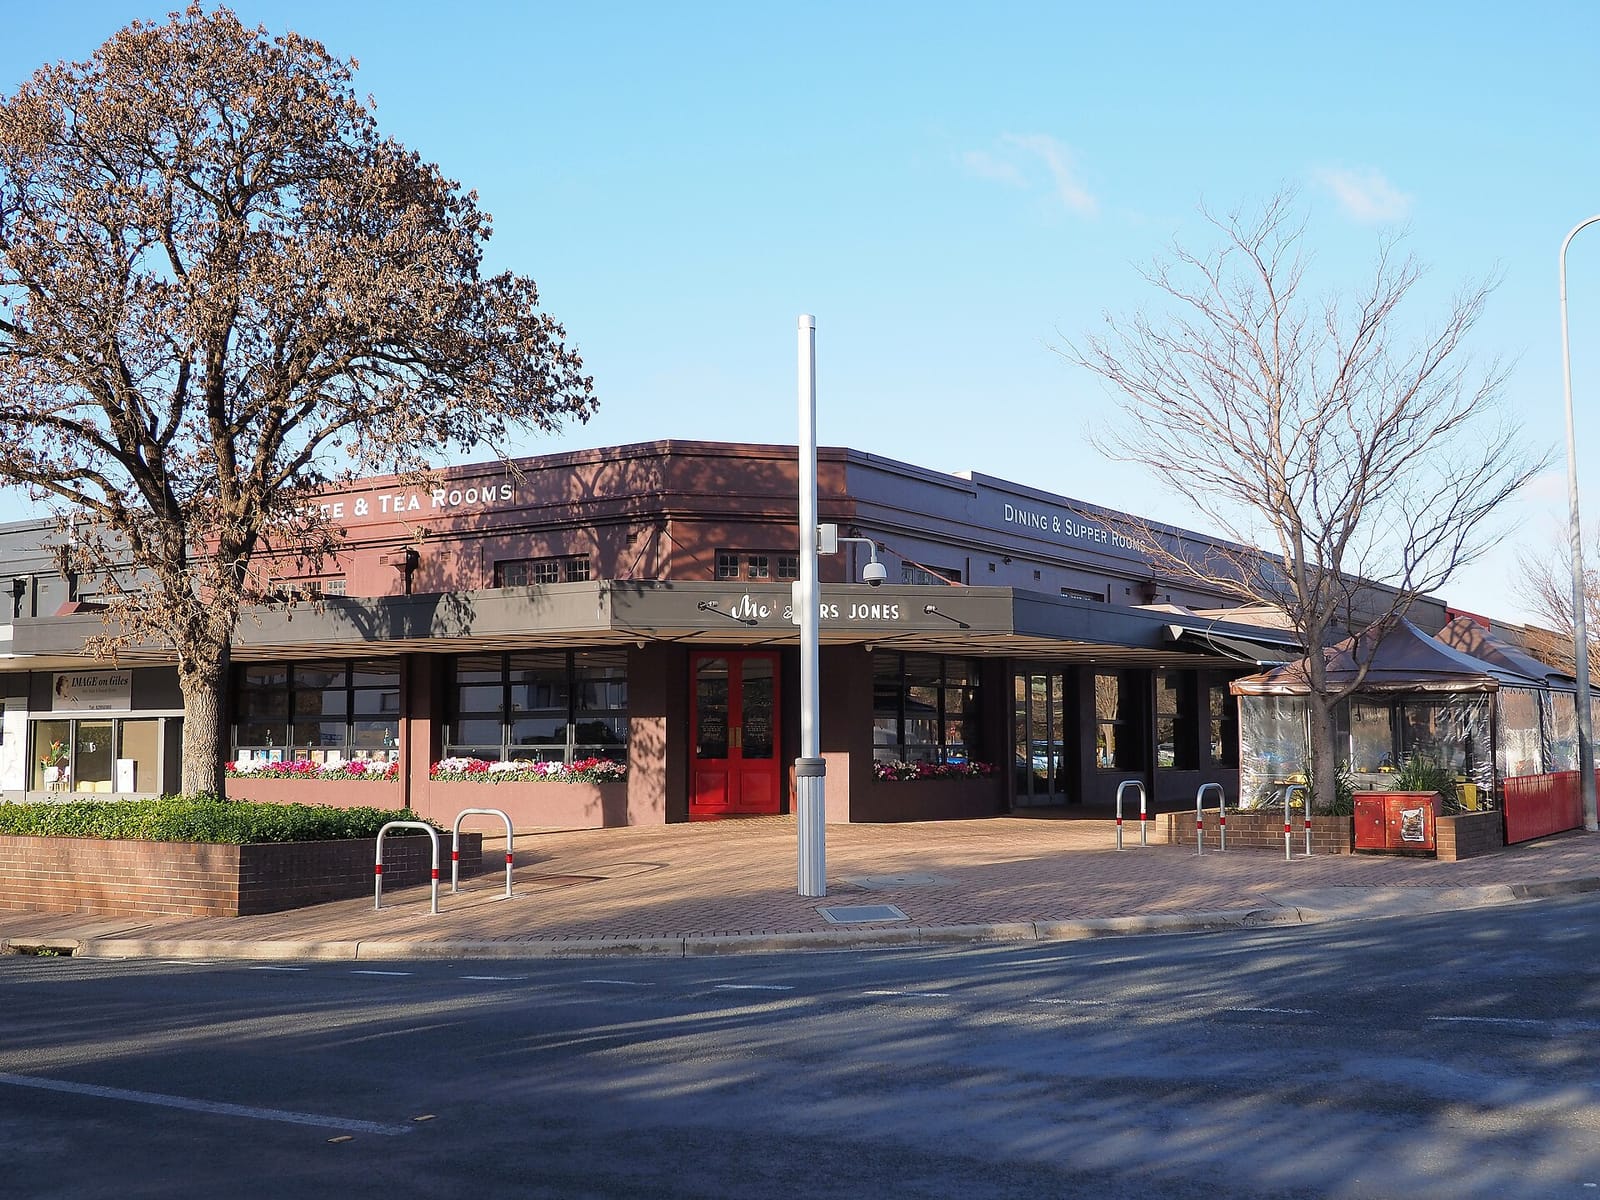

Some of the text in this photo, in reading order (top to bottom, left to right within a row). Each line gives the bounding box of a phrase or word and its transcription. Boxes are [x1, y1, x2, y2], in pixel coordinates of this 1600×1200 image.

[354, 497, 369, 516] &
[378, 494, 421, 513] TEA
[431, 484, 513, 508] ROOMS
[1004, 503, 1146, 553] DINING & SUPPER ROOMS
[819, 603, 839, 619] RS
[848, 603, 900, 620] JONES
[71, 675, 129, 688] IMAGE on Giles
